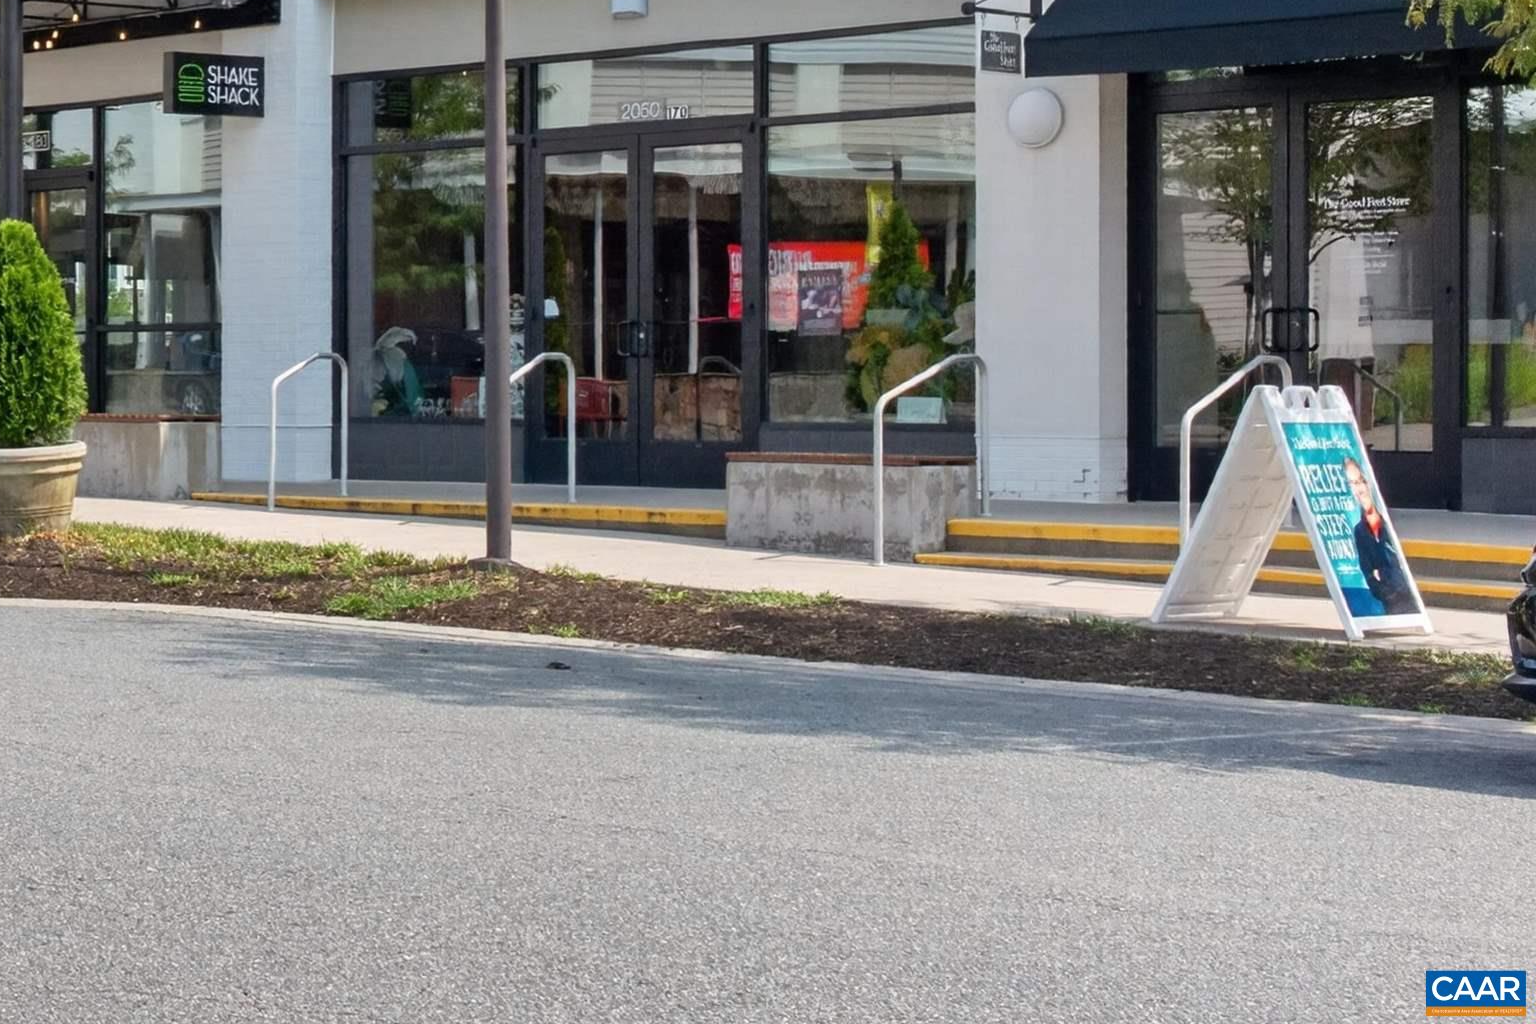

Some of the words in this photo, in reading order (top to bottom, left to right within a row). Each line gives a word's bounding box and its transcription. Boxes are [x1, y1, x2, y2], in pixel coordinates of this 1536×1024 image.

[207, 64, 259, 86] SHAKE
[207, 85, 260, 106] SHACK
[621, 100, 661, 120] 2060
[1298, 464, 1347, 494] RELIEF
[1316, 514, 1352, 537] STEPS
